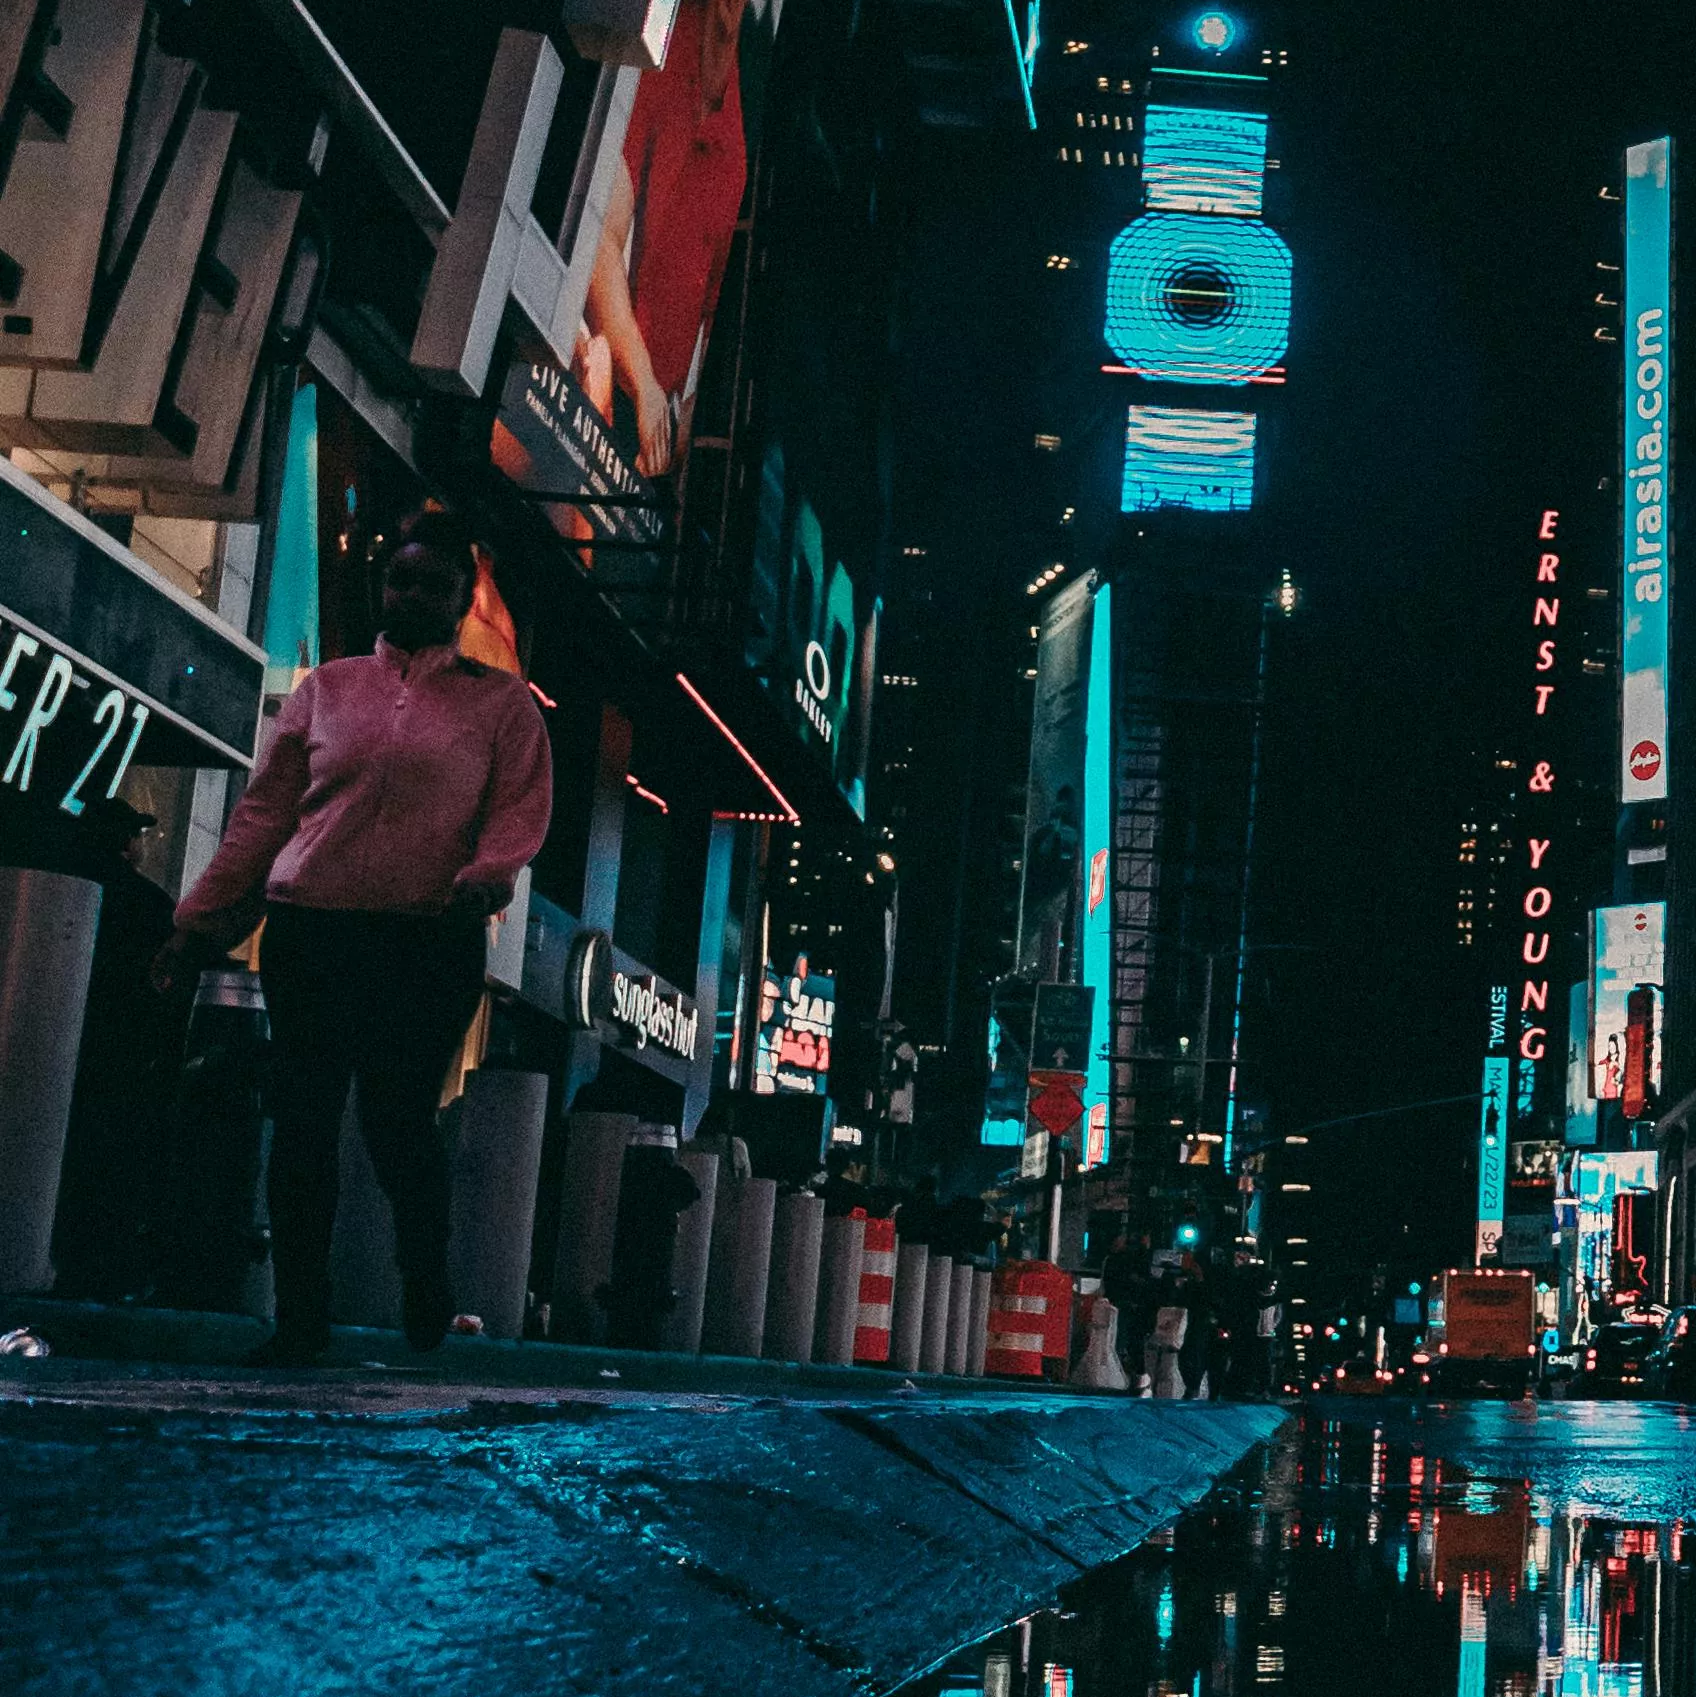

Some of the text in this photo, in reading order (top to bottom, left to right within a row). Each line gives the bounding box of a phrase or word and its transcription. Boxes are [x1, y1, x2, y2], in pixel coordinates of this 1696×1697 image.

[532, 363, 569, 413] LIVE
[1628, 308, 1662, 602] airasia.com
[59, 689, 150, 816] 21
[1520, 510, 1559, 1060] ERNST & YOUNG
[612, 972, 673, 1050] sunglass
[674, 993, 698, 1061] hut
